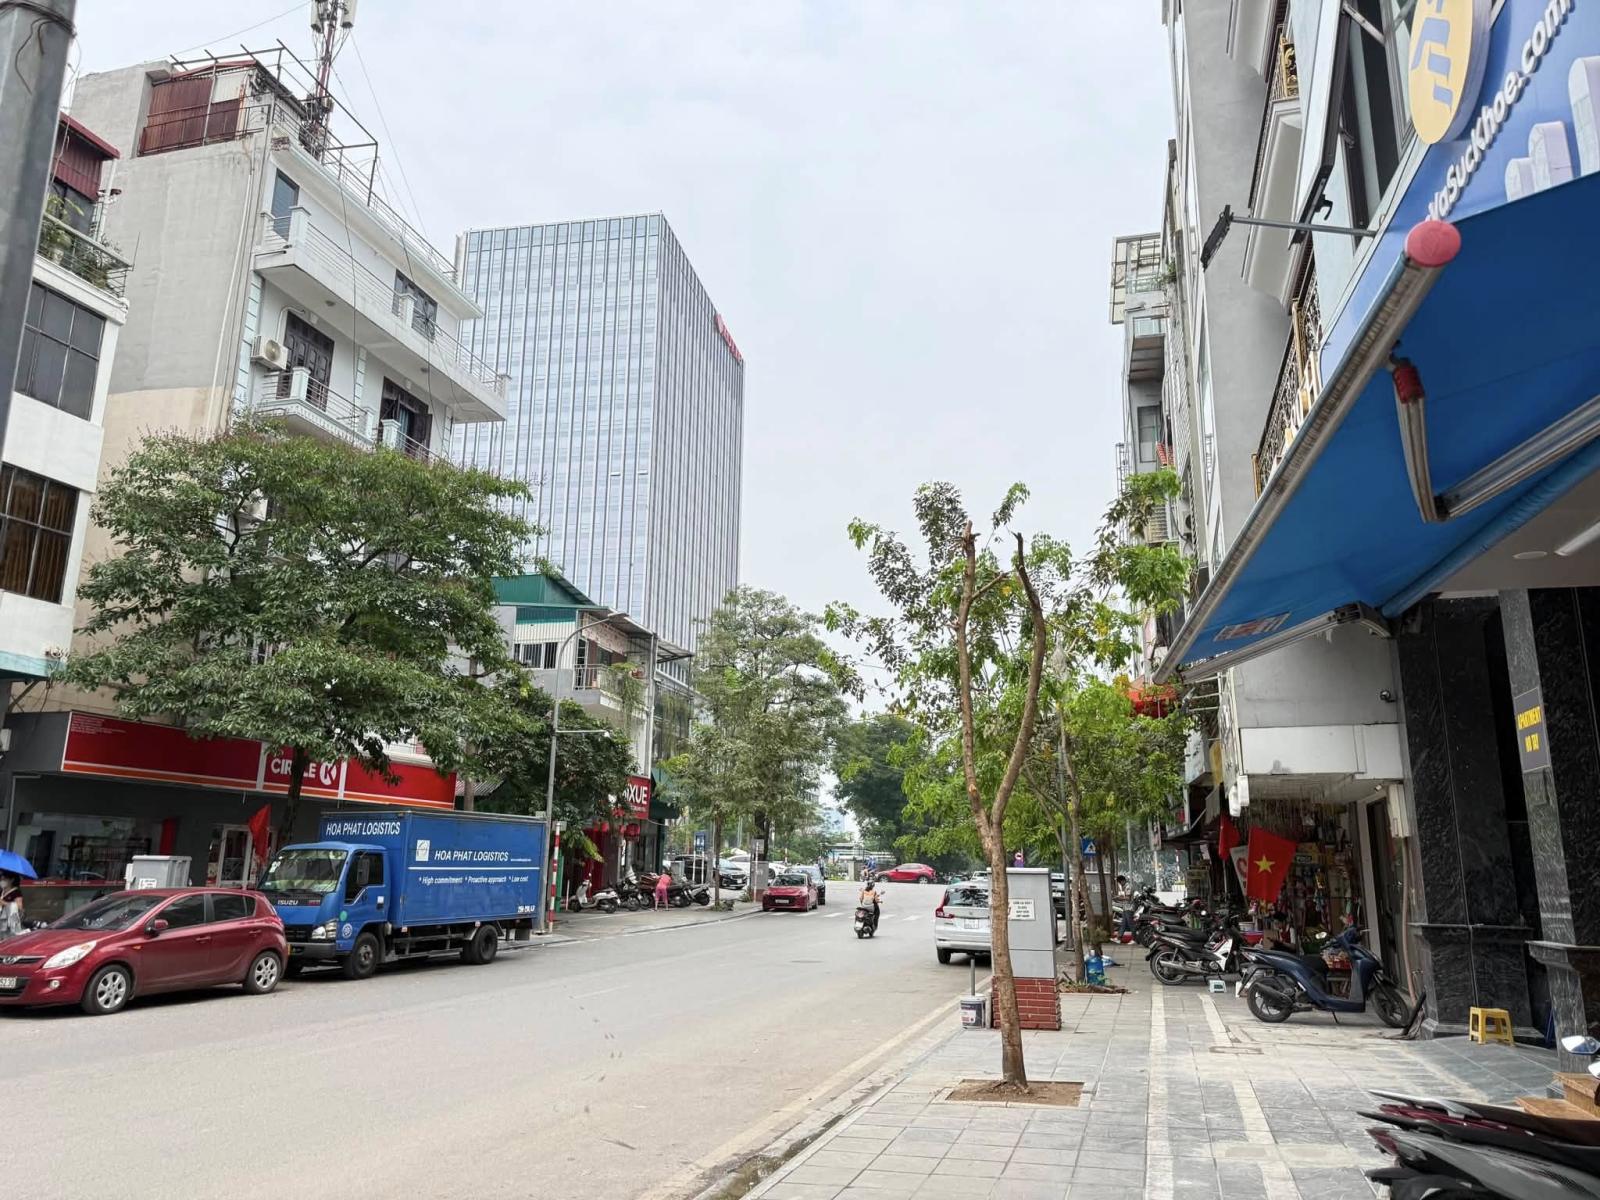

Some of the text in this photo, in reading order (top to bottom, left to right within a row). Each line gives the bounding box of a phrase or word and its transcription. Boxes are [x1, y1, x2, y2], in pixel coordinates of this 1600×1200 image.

[271, 758, 317, 778] CIRE
[326, 822, 400, 835] HOA PHAT LOGISTICS
[434, 850, 451, 861] HOA
[452, 850, 472, 861] PHAT
[473, 851, 509, 861] LOGISTICS
